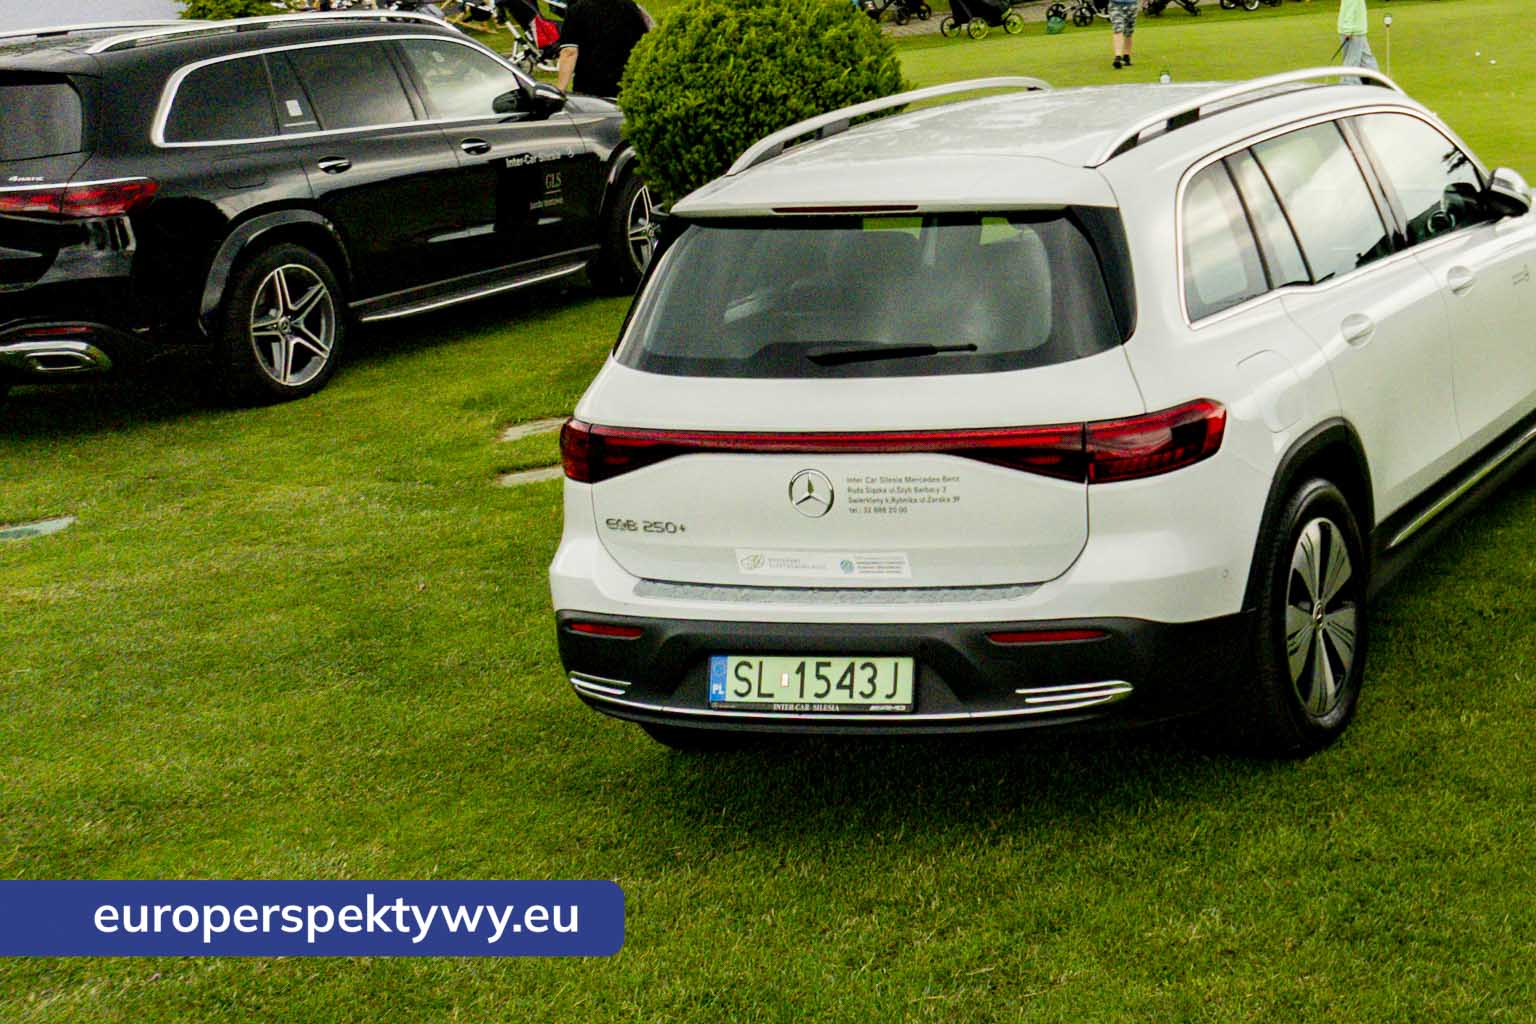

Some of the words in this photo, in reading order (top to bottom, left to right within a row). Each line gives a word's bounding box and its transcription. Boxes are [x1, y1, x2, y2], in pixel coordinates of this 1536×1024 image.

[606, 518, 638, 532] EQB
[734, 661, 774, 698] SL
[795, 661, 899, 699] 1543J
[712, 683, 724, 694] PL
